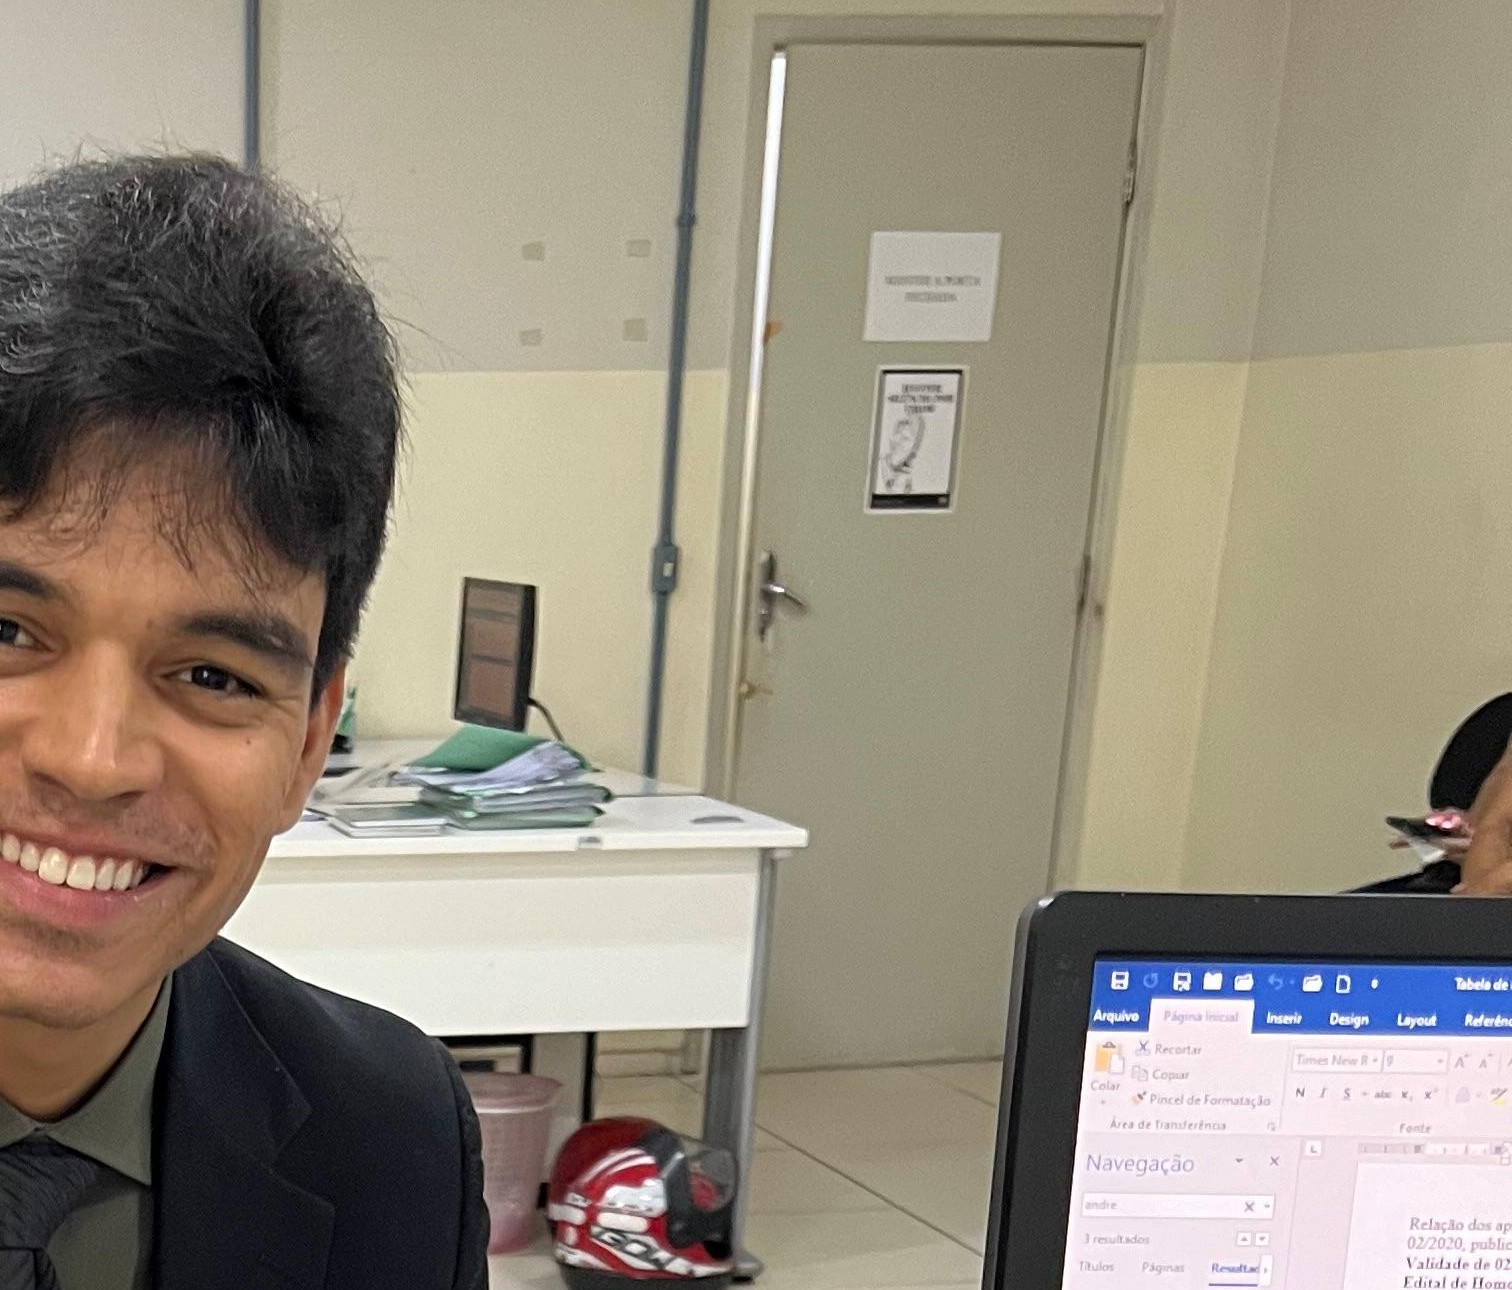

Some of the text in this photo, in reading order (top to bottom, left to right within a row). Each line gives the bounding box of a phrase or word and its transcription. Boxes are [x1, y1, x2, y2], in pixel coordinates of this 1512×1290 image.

[1493, 978, 1508, 991] de
[1093, 1010, 1140, 1024] Arquivo
[1164, 1010, 1202, 1025] Página
[1206, 1011, 1239, 1022] Inicial
[1266, 1012, 1302, 1026] Inserir
[1330, 1013, 1369, 1029] Design
[1397, 1013, 1437, 1029] Layout
[1155, 1044, 1202, 1055] Recortar
[1297, 1054, 1358, 1066] Times New
[1153, 1069, 1190, 1080] Copiar
[1091, 1081, 1120, 1090] Colar
[1150, 1094, 1271, 1108] Pincel de Formatação
[1110, 1118, 1226, 1130] Área de Transferência
[1400, 1123, 1431, 1133] Fonte
[1087, 1154, 1194, 1177] Navegação
[1086, 1201, 1117, 1210] andre
[1409, 1217, 1492, 1233] Relação dos
[1093, 1234, 1150, 1245] resultados
[1408, 1237, 1466, 1252] 02/2020,
[1142, 1262, 1185, 1275] Páginas
[1407, 1257, 1490, 1270] Validade de
[1403, 1276, 1467, 1289] Edital de
